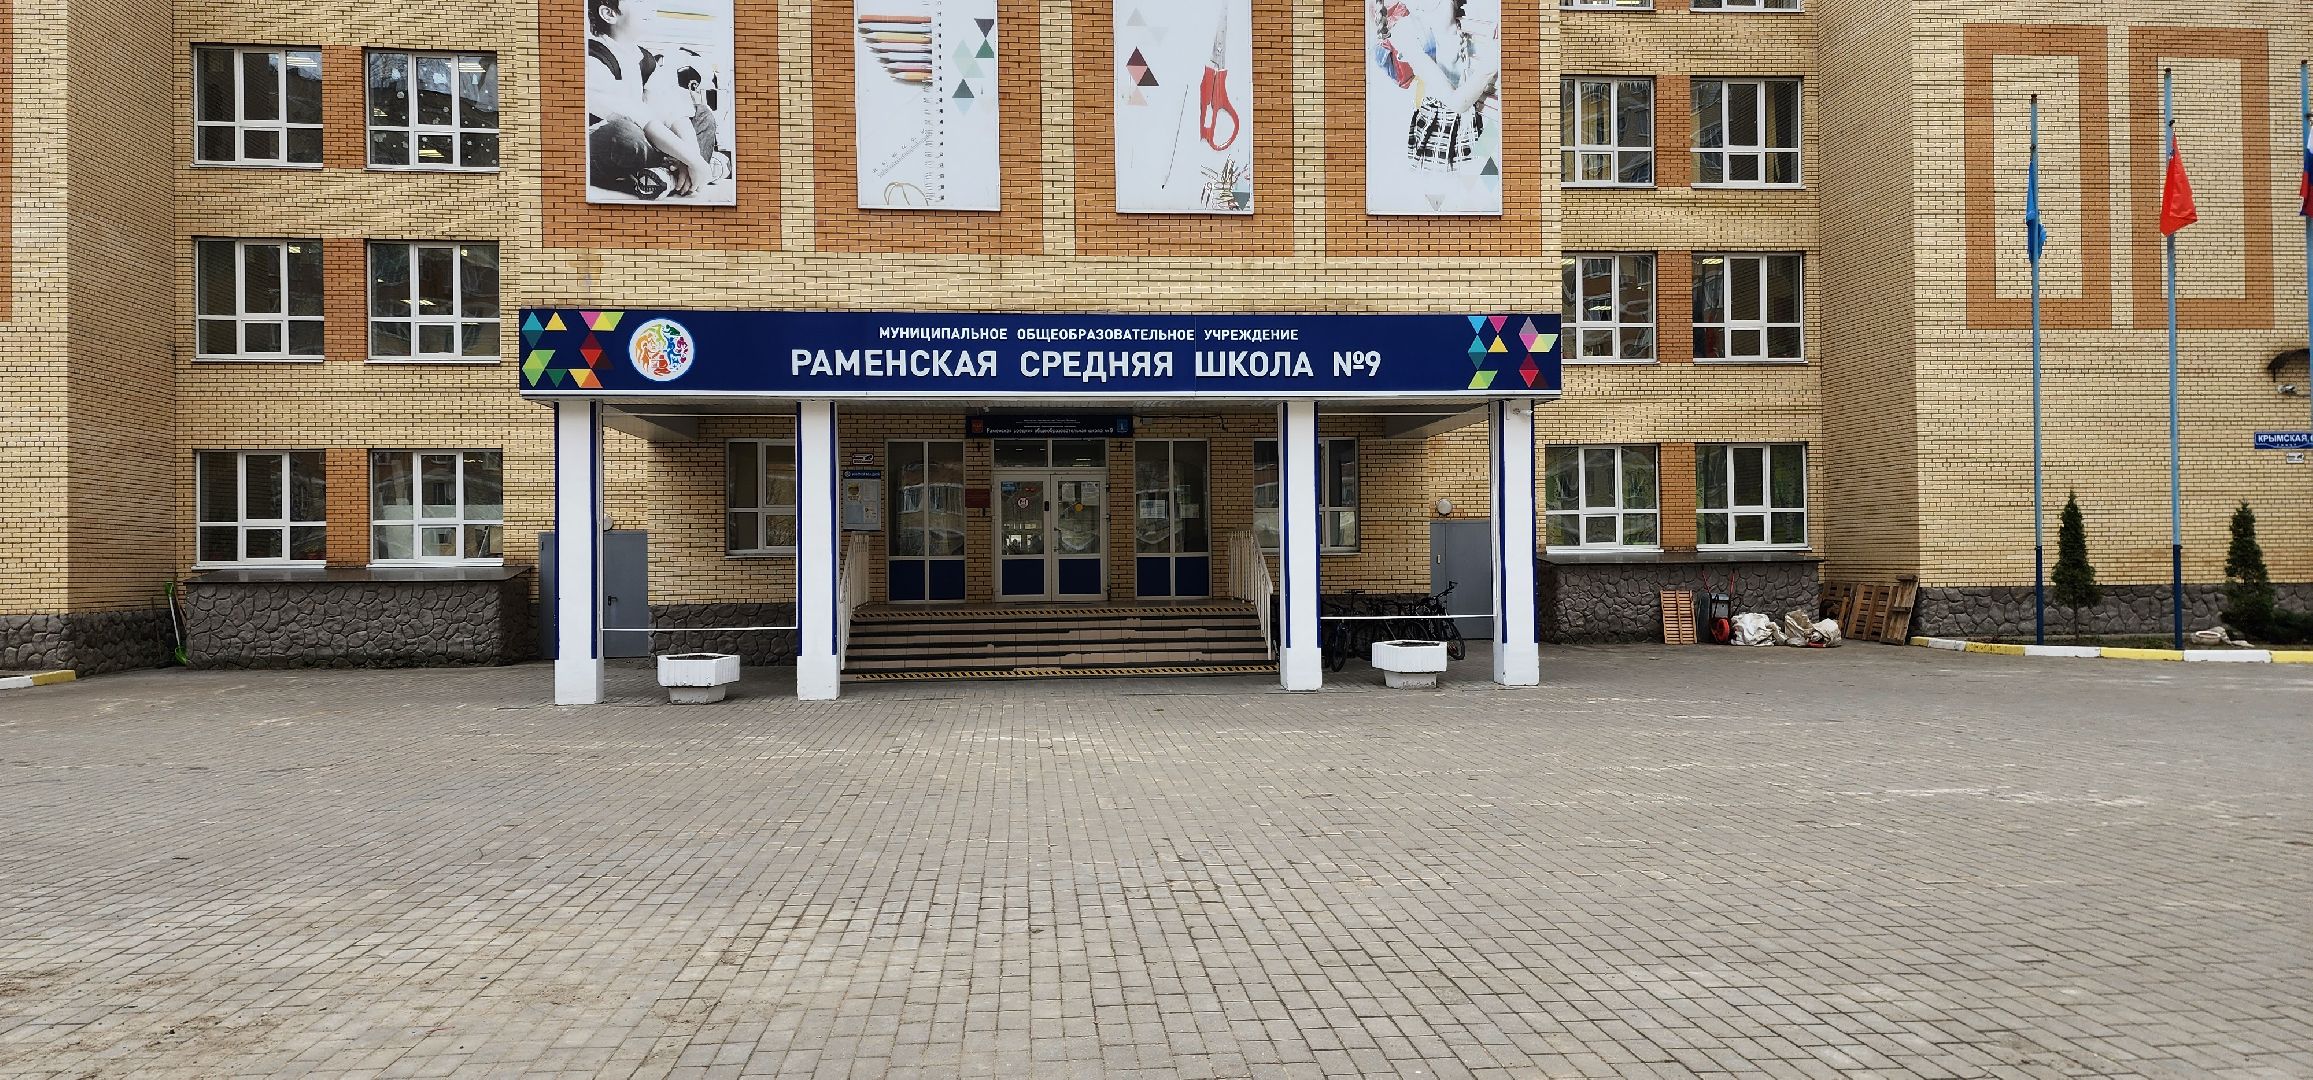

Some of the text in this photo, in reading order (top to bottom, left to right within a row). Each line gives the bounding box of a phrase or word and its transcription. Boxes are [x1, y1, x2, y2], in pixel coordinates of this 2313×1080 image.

[879, 326, 1299, 342] МУНИЦИПАЛЬНОЕ ОБЩЕОБРАЗОВАТЕЛЬНОЕ УЧРЕЖДЕНИЕ
[790, 348, 1382, 382] РАМЕНСКАЯ СРЕДНЯЯ ШКОЛА №9
